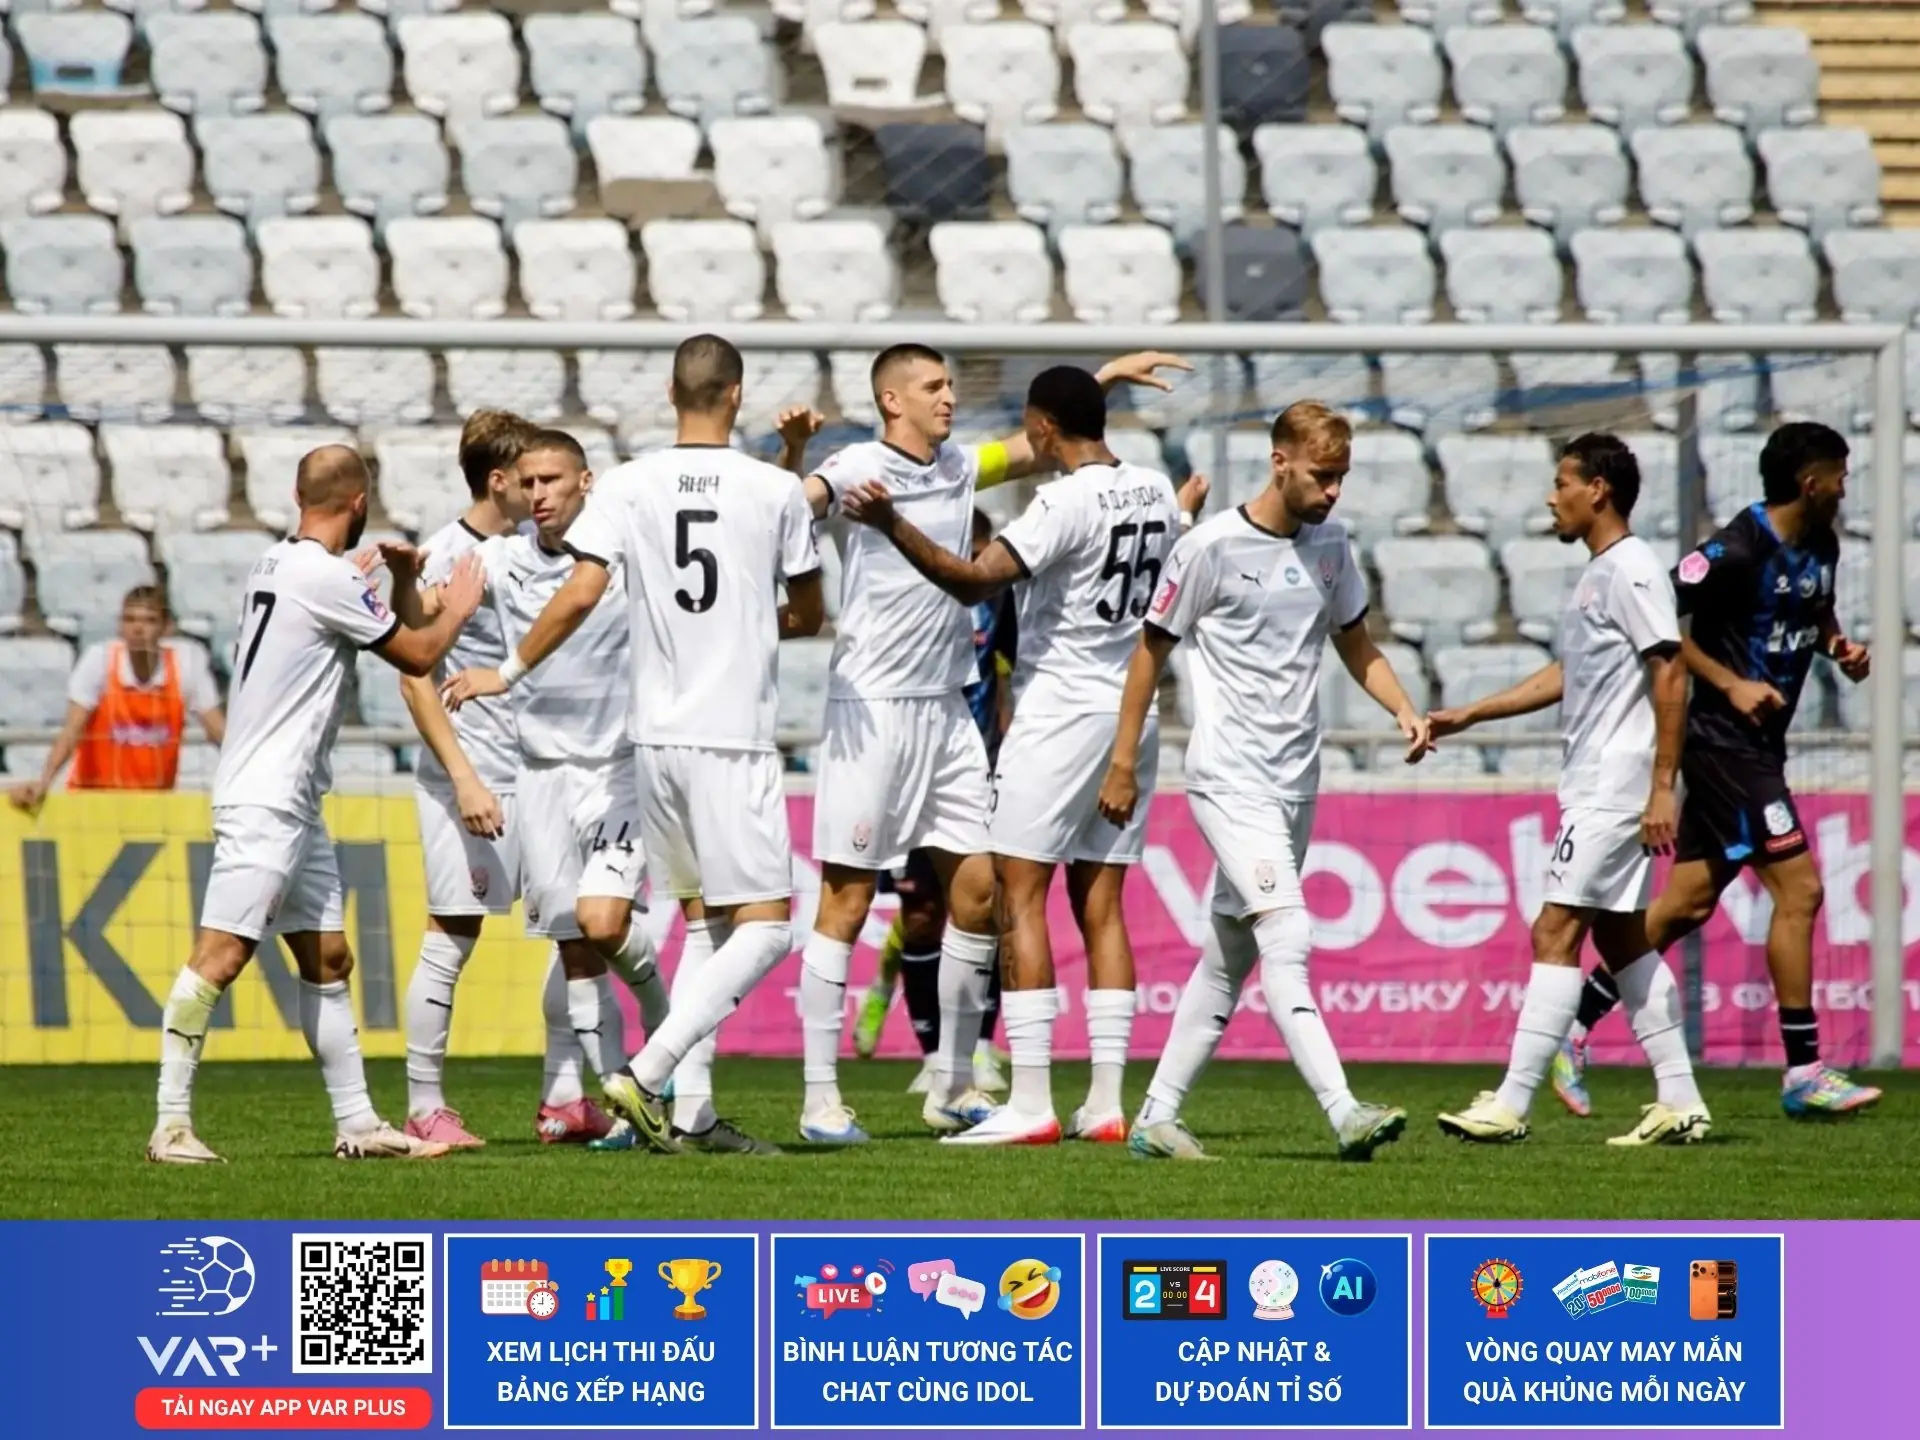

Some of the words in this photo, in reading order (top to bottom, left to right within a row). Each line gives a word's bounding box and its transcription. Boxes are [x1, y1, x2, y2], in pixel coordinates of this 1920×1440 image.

[674, 509, 719, 614] 5
[1096, 521, 1166, 623] 55
[593, 821, 635, 858] 44
[1320, 981, 1470, 1013] КУБКУ
